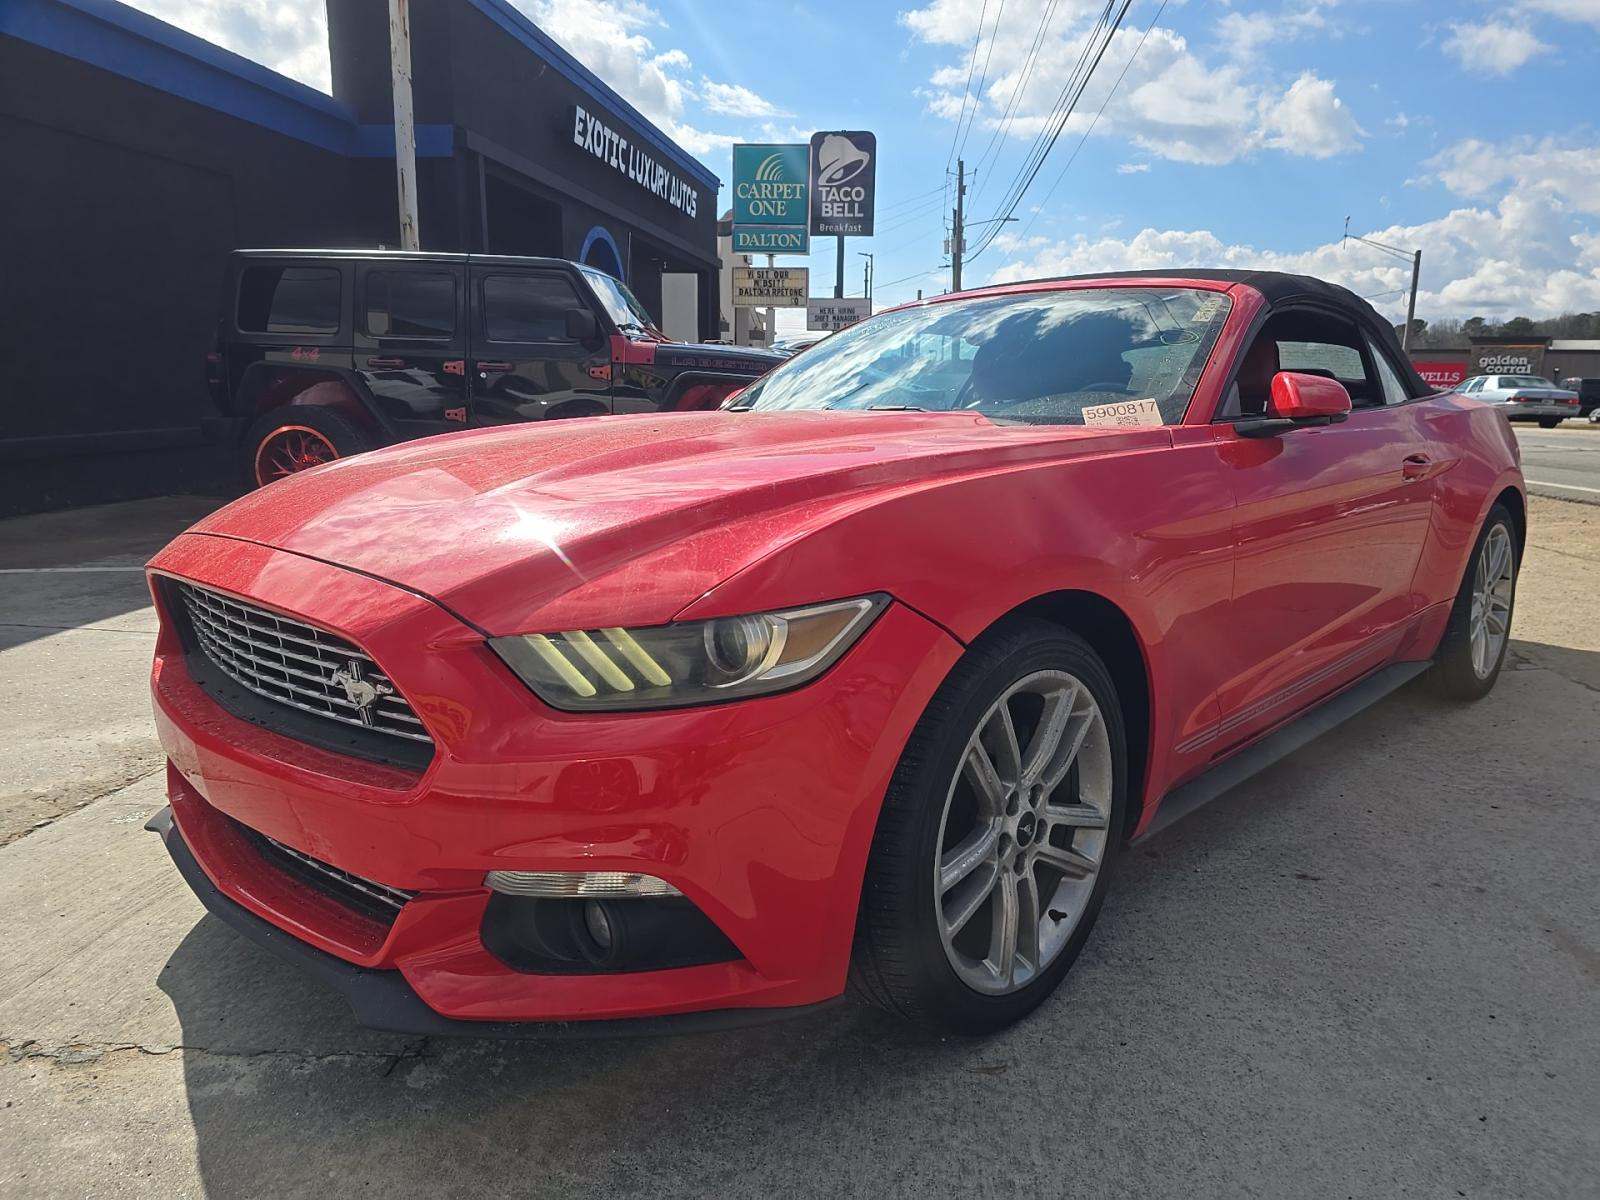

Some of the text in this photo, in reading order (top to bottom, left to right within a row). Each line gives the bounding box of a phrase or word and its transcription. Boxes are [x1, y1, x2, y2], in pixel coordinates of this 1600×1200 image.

[574, 105, 698, 219] EXOTIC LUXURY AUTOS
[736, 183, 805, 199] CARPET
[818, 187, 865, 202] TACO
[749, 200, 787, 217] ONE
[821, 203, 864, 217] BELL
[819, 223, 862, 232] Breakfast
[739, 233, 801, 247] DALTON
[773, 270, 789, 279] OUR
[1479, 355, 1528, 368] golden
[1485, 364, 1532, 374] corral
[1417, 371, 1460, 382] WELLS
[1086, 401, 1156, 419] 5900817
